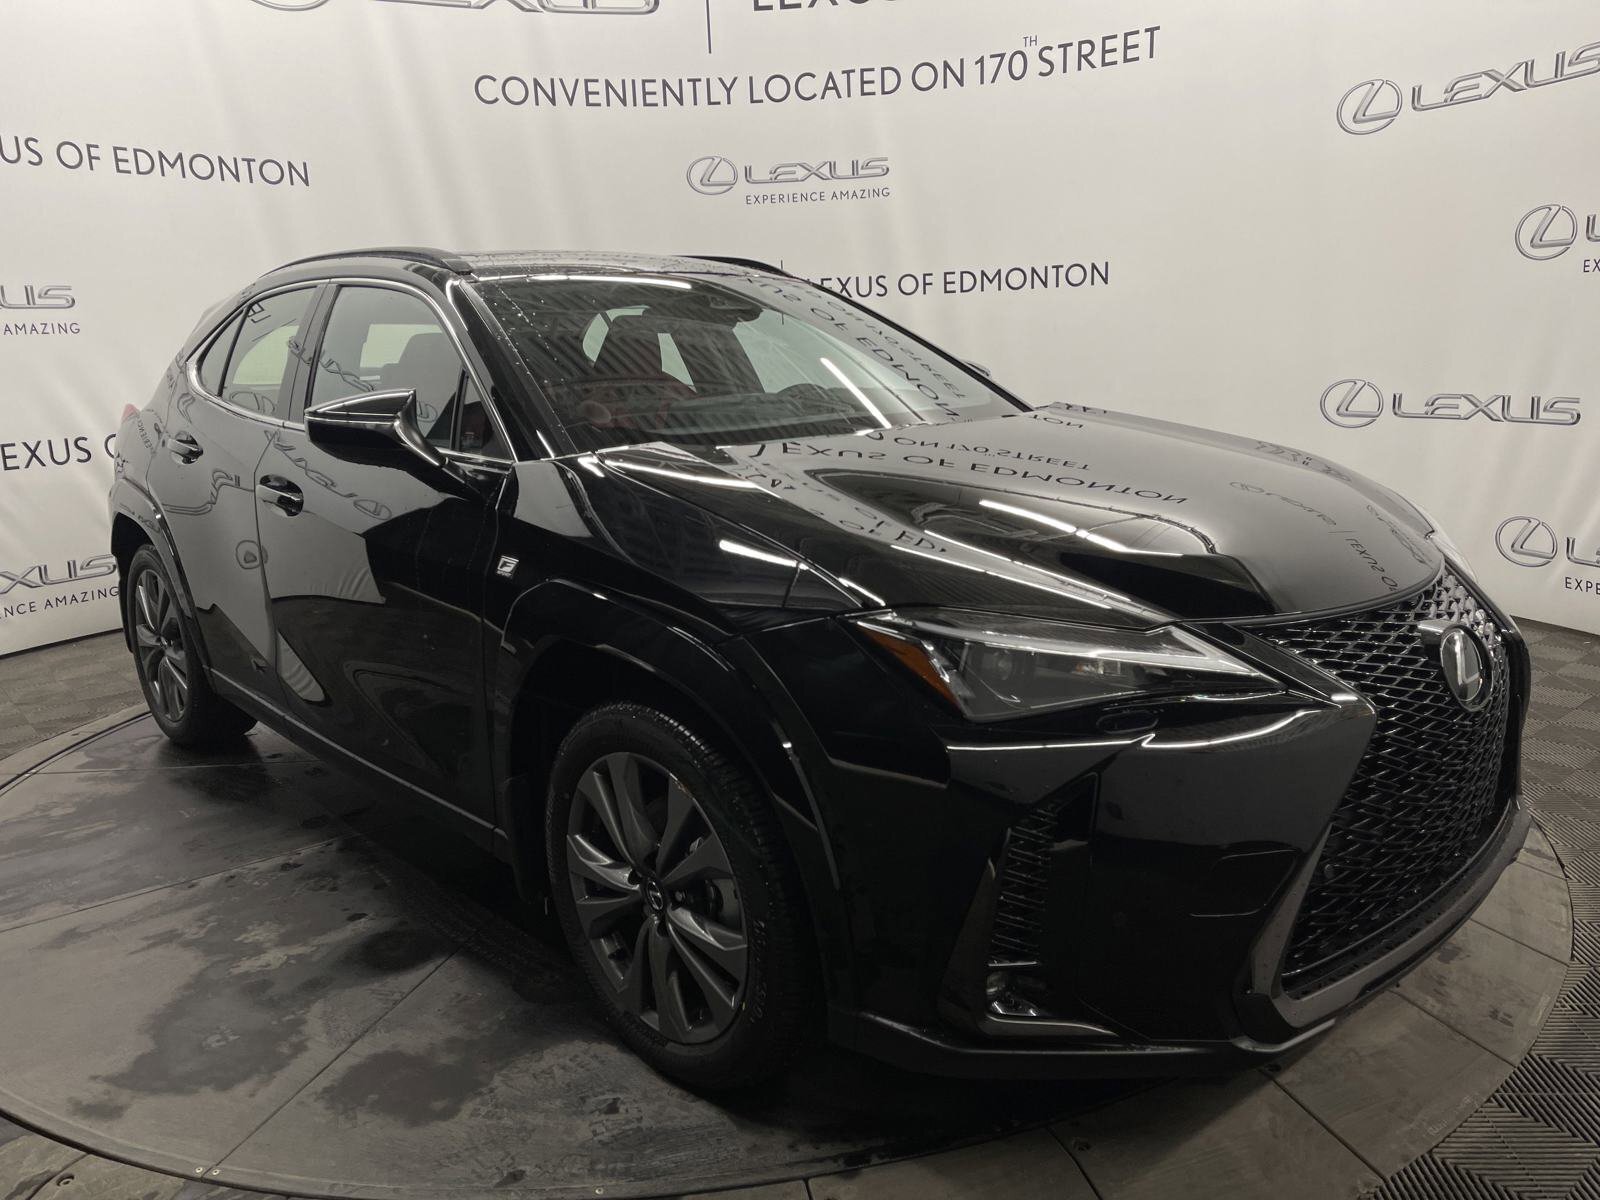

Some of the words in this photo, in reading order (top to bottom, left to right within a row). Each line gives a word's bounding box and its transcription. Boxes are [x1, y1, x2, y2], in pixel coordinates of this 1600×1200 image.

[474, 74, 738, 107] CONVENIENTLY
[748, 66, 902, 104] LOCATED
[911, 57, 965, 92] ON
[1037, 25, 1161, 77] STREET
[1411, 40, 1600, 112] LEXUS
[56, 141, 101, 171] OF
[112, 145, 310, 187] EDMONTON
[744, 157, 890, 184] LEXUS
[745, 191, 826, 205] EXPERIENCE
[831, 187, 890, 201] AMAZING
[898, 273, 934, 296] OF
[943, 261, 1110, 294] EDMONTON
[4, 322, 81, 335] AMAZING
[1392, 392, 1582, 426] LEXUS
[0, 436, 92, 471] EXUS
[44, 586, 120, 610] AMAZING
